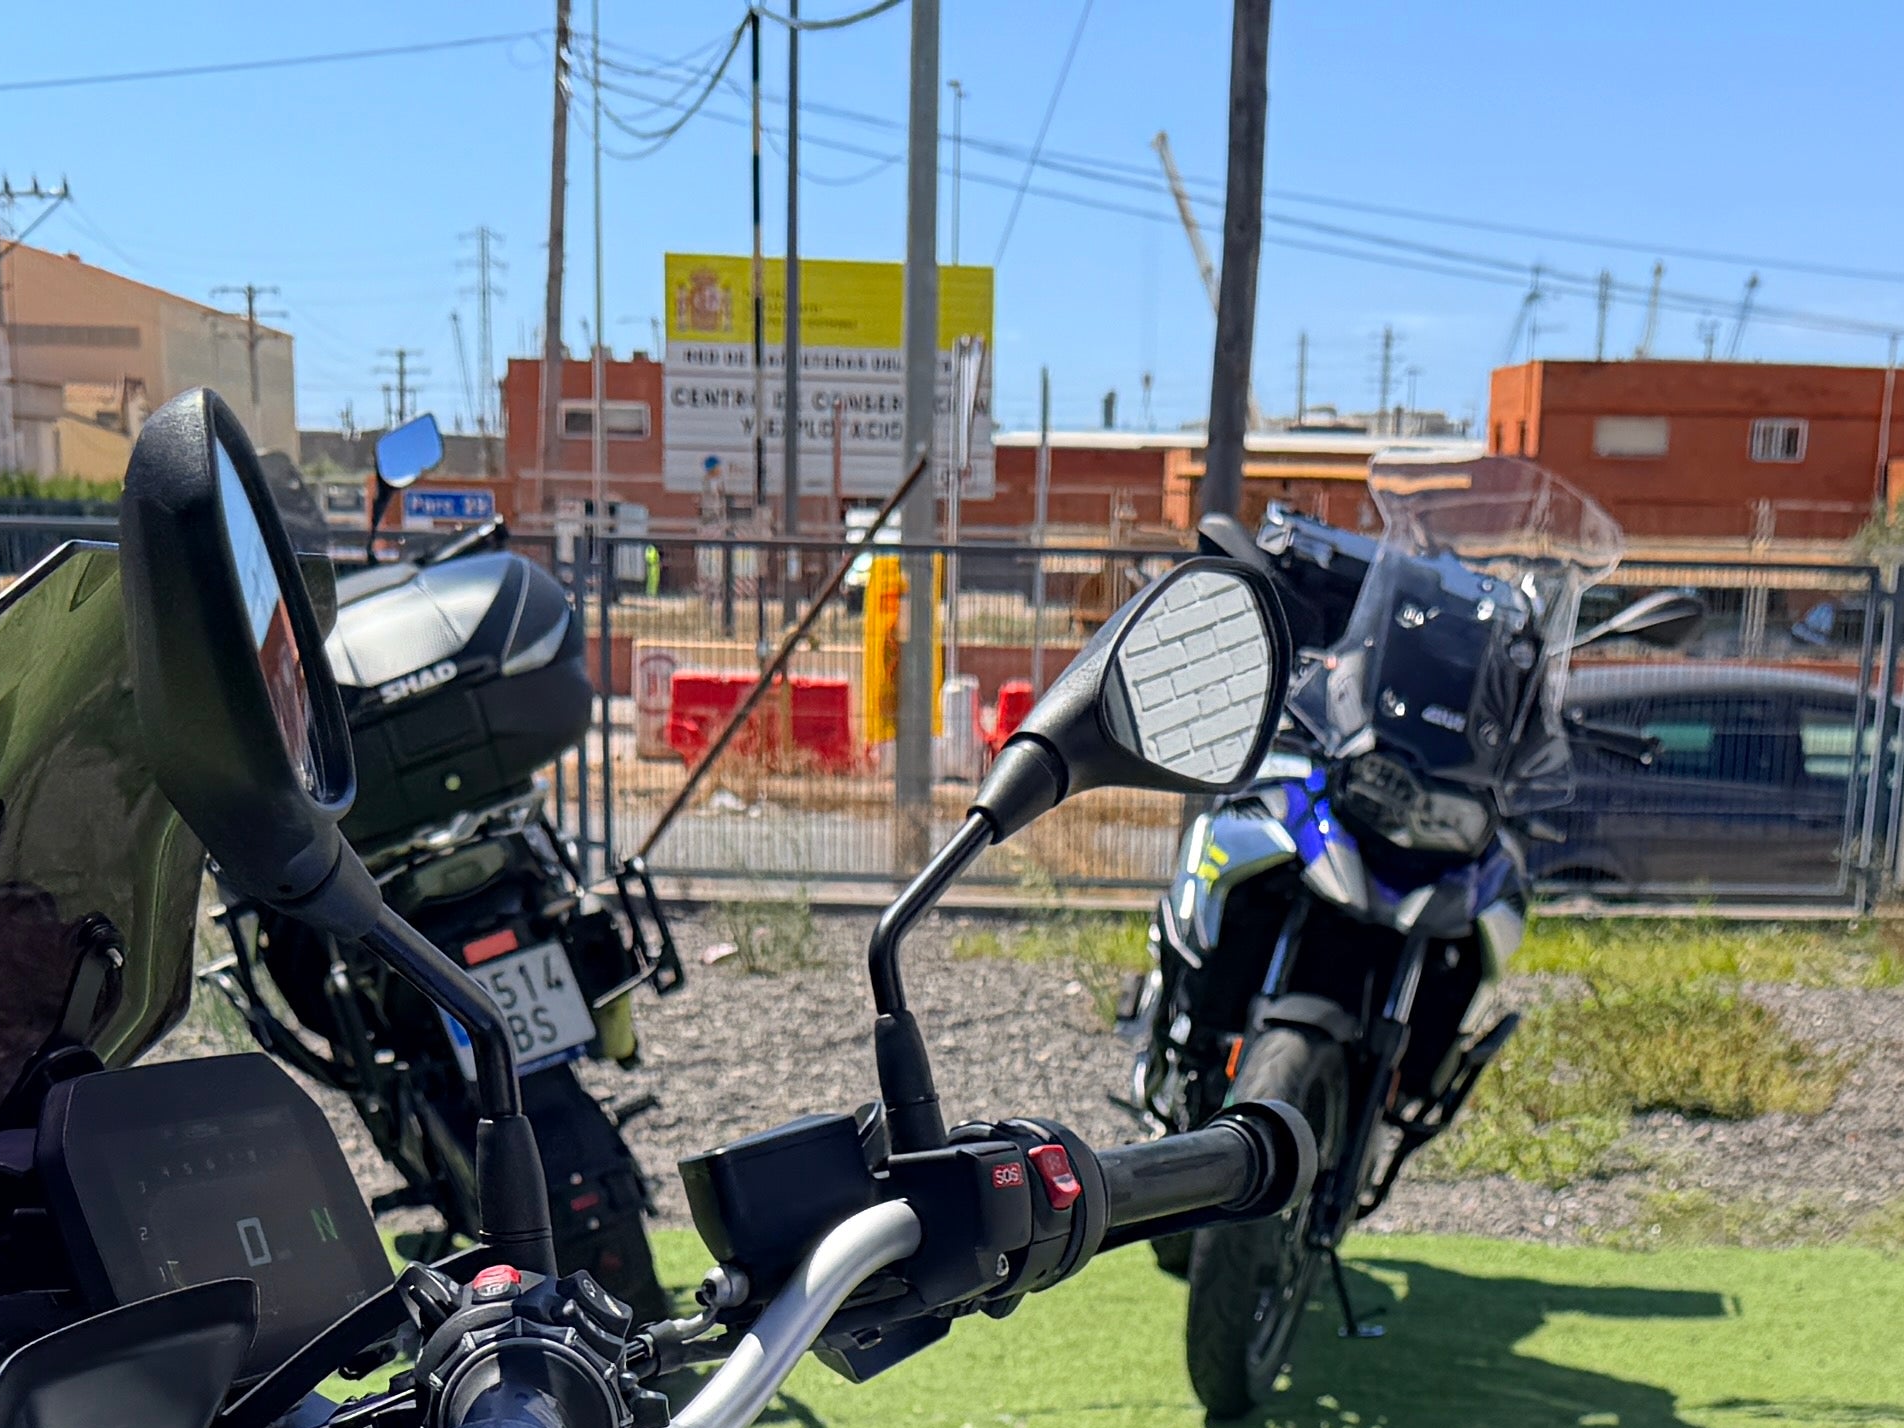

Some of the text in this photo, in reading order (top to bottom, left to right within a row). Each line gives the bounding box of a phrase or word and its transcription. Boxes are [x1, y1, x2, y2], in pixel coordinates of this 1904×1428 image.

[379, 660, 457, 704] SHAD
[476, 954, 565, 1010] 514
[506, 1005, 558, 1053] BS
[995, 1167, 1019, 1185] SOS
[236, 1216, 272, 1267] 0
[310, 1207, 339, 1242] N
